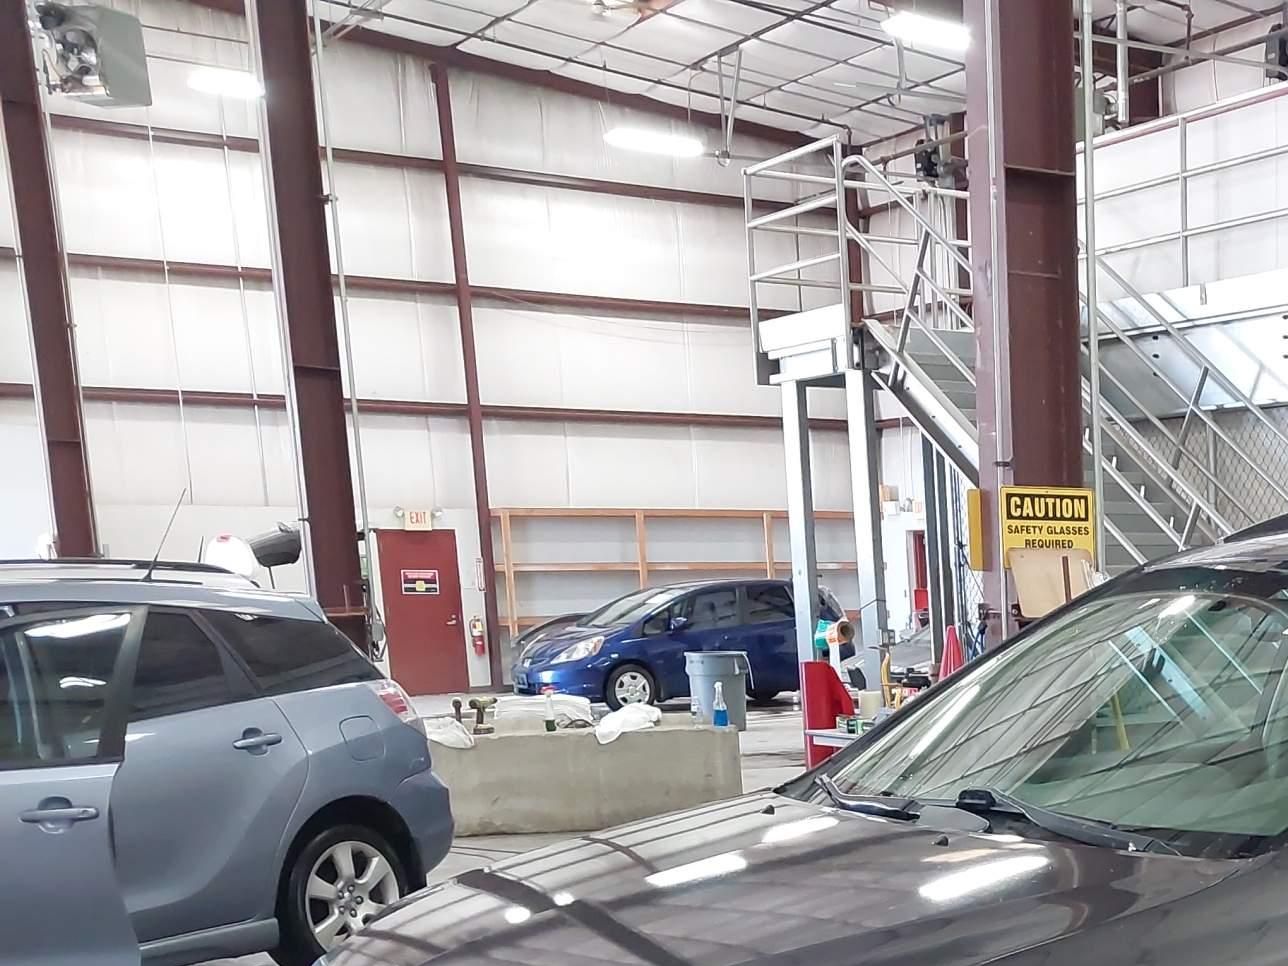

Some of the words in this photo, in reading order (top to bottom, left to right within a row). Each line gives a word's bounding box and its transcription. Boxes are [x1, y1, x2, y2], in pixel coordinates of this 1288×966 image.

[1010, 496, 1086, 519] CAUTION
[409, 511, 426, 524] EXIT
[1007, 524, 1043, 535] SAFETY
[1046, 525, 1090, 536] GLASSES
[1025, 539, 1074, 549] REQUIRED
